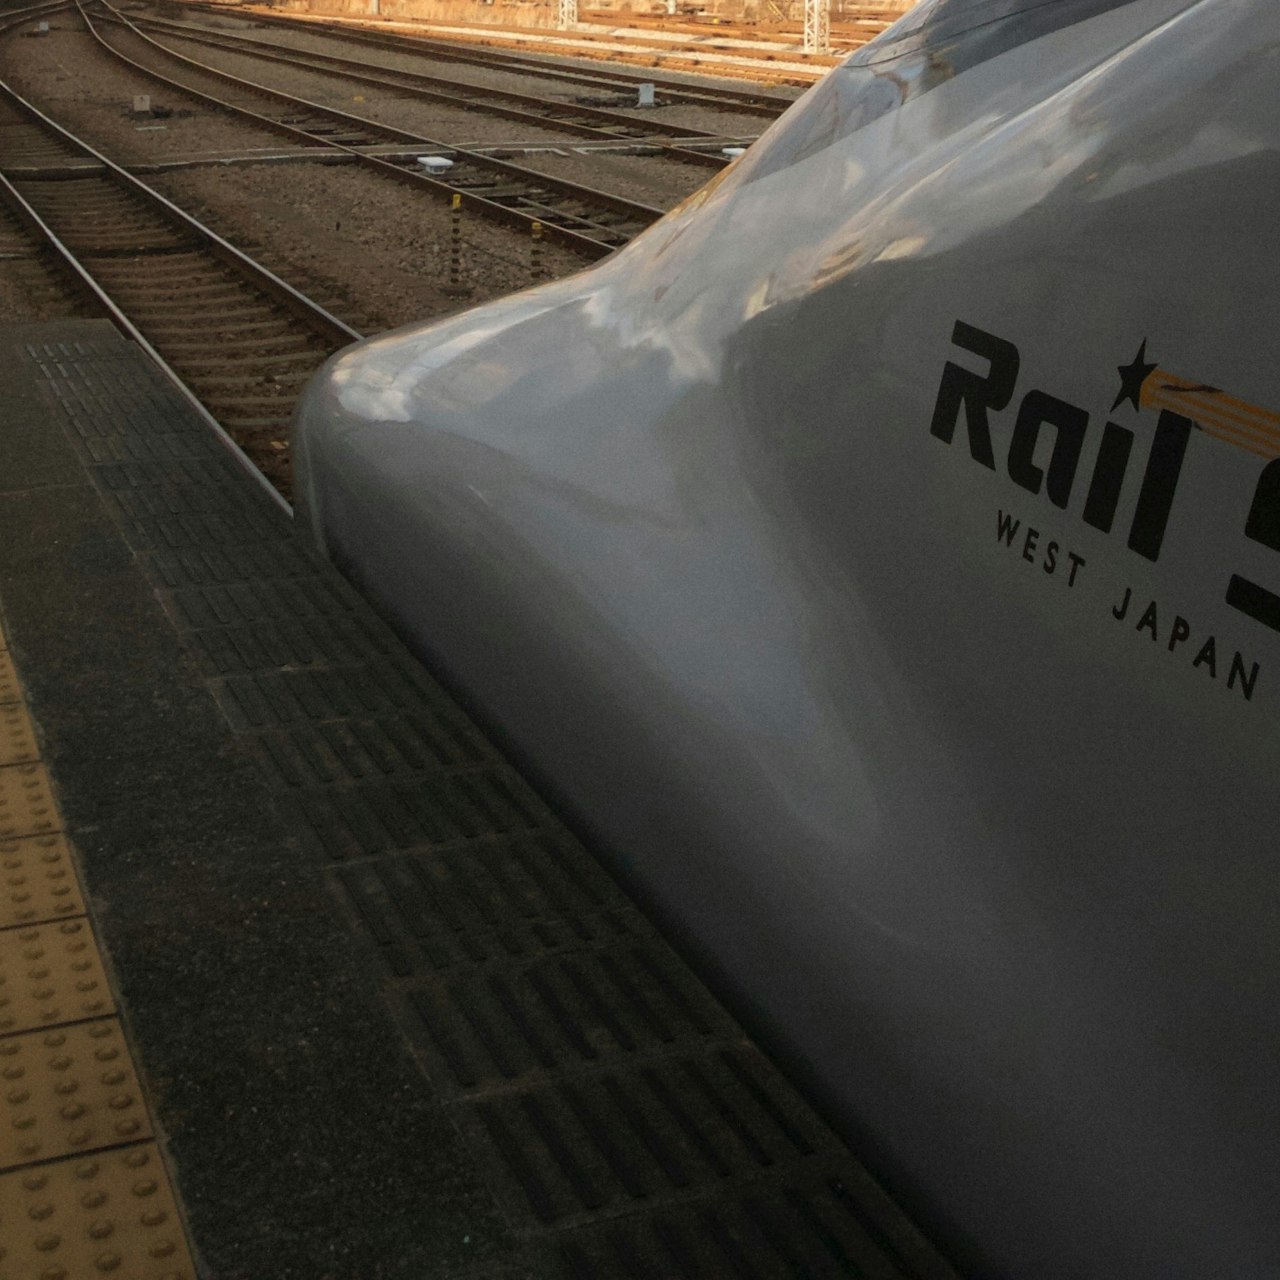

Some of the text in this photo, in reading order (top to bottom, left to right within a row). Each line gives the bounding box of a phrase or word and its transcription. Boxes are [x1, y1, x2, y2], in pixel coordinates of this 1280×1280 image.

[930, 319, 1193, 563] Rail
[995, 509, 1086, 588] WEST
[1111, 587, 1260, 701] JAPAN
